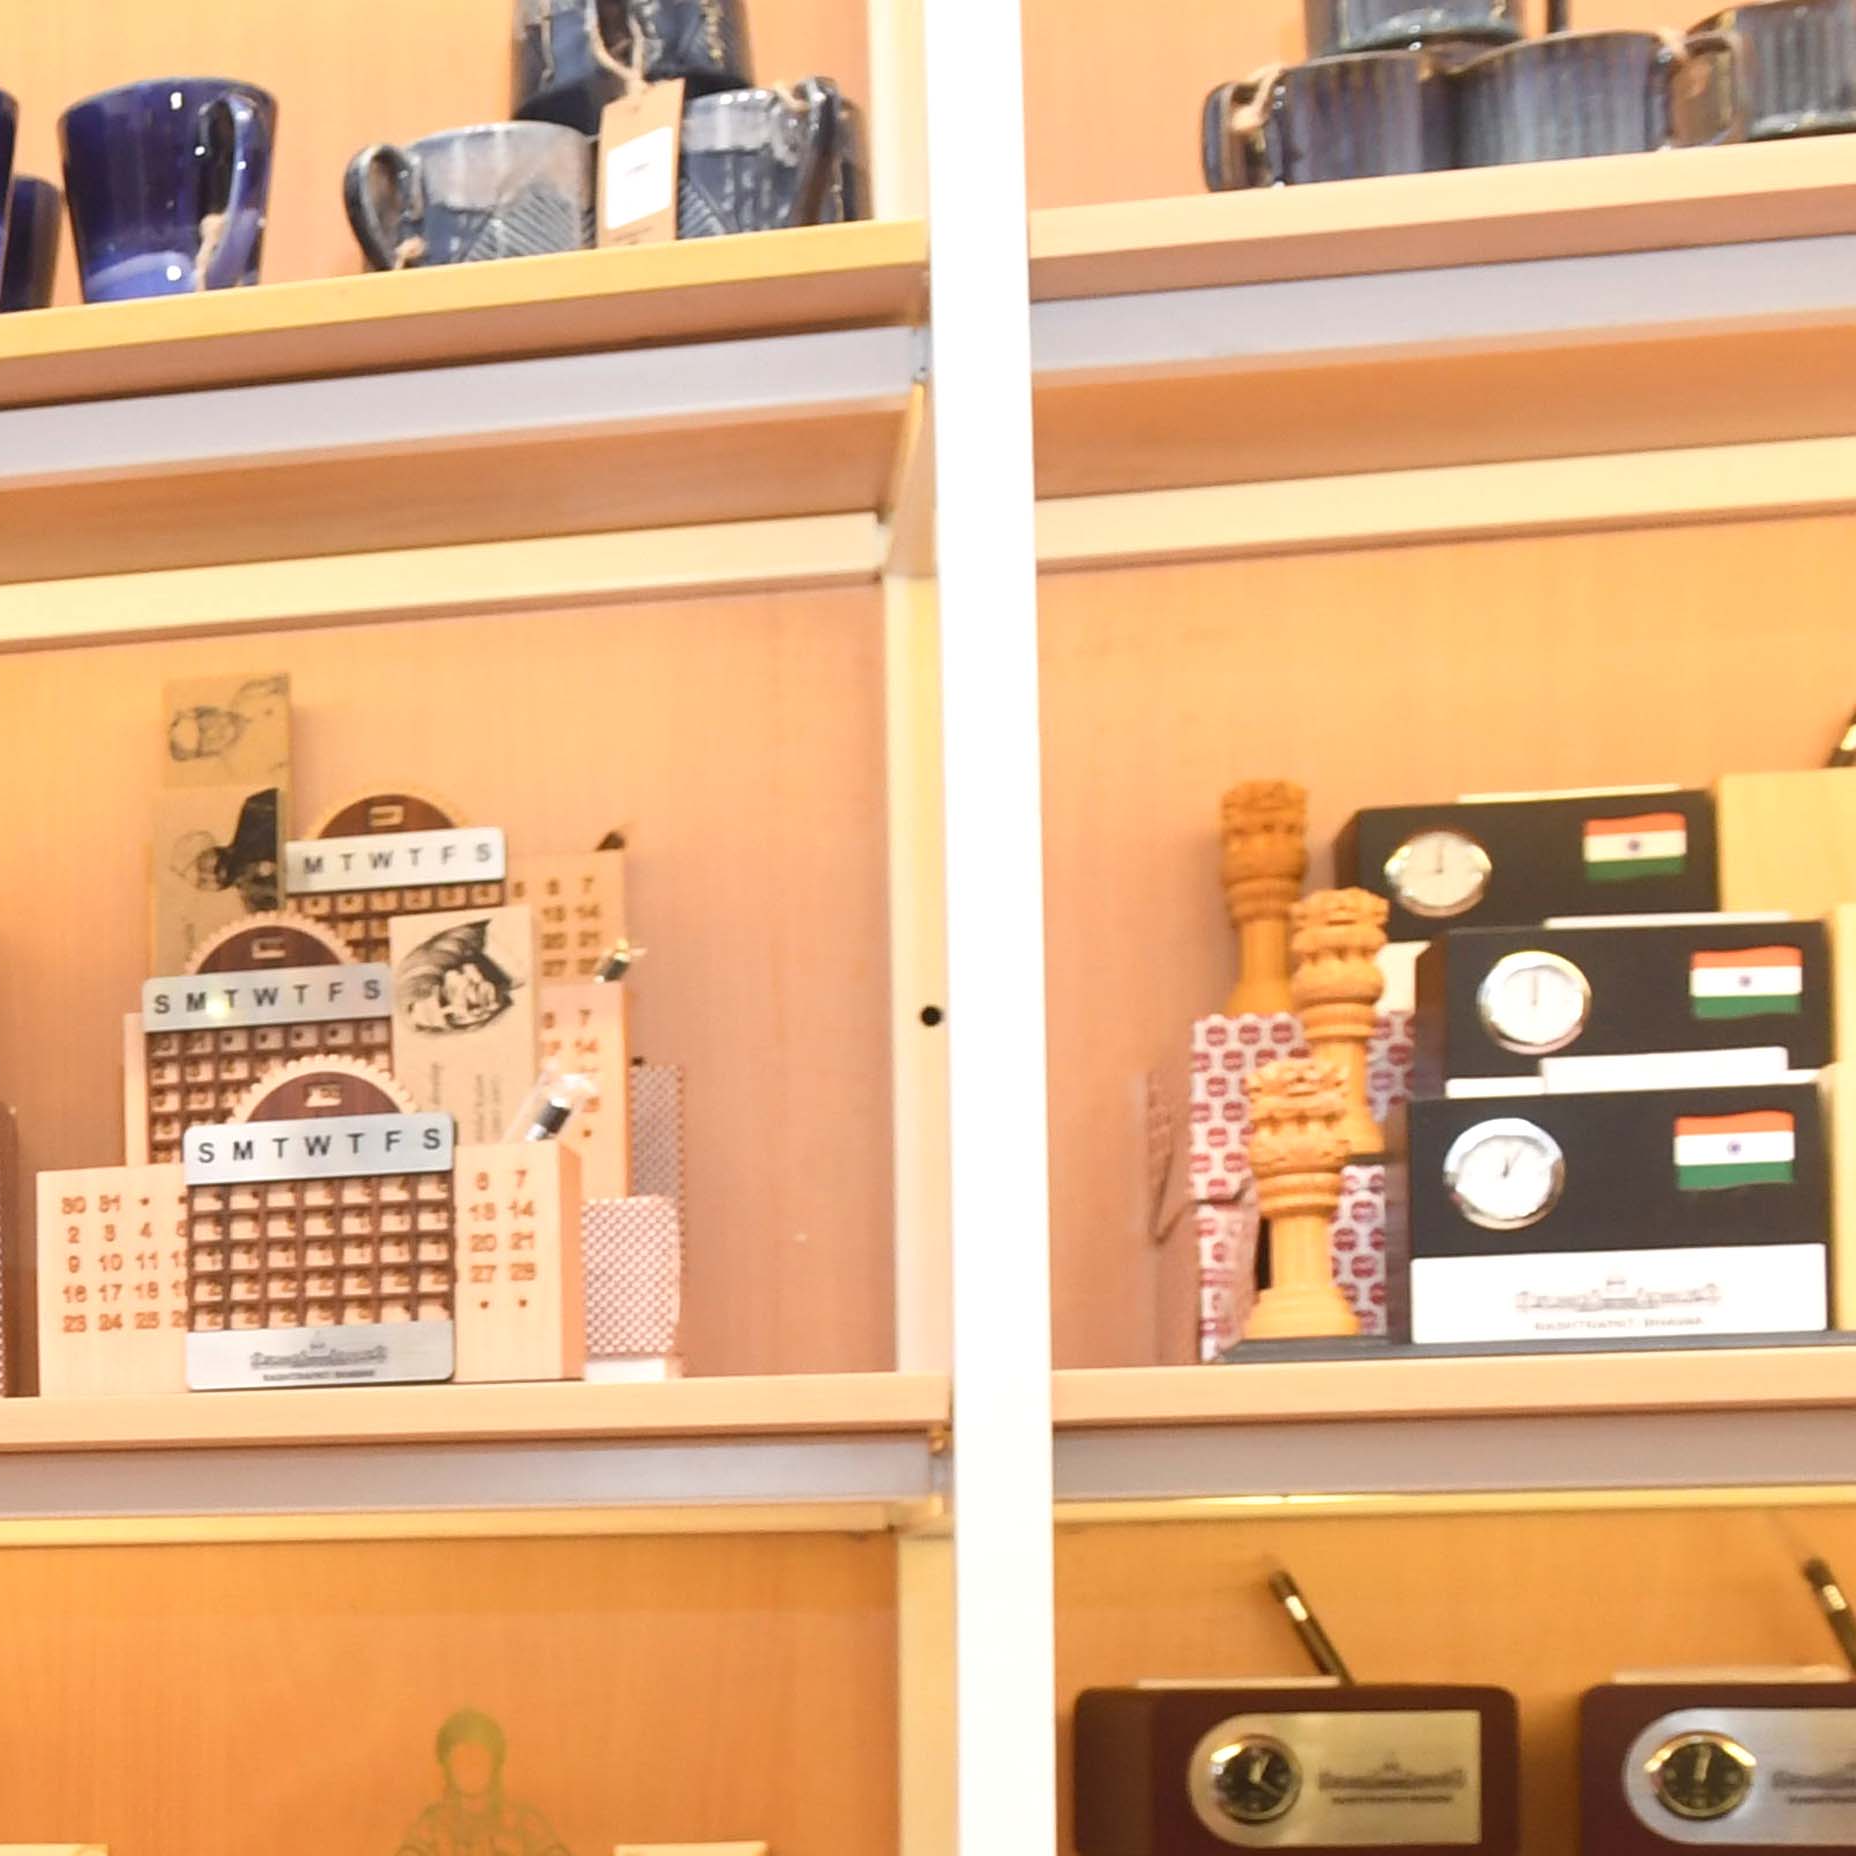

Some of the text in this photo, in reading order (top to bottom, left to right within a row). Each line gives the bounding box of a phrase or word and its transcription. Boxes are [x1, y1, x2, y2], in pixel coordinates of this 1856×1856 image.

[304, 844, 492, 874] M T W T F S
[154, 980, 381, 1014] S M T W T F S
[198, 1128, 441, 1164] S M T W T F S
[516, 1171, 527, 1189] 7
[509, 1202, 535, 1219] 14
[68, 1226, 79, 1244] 2
[140, 1222, 153, 1239] 4
[68, 1253, 159, 1273] 9 10 11
[99, 1284, 123, 1302] 17
[98, 1313, 123, 1331] 24
